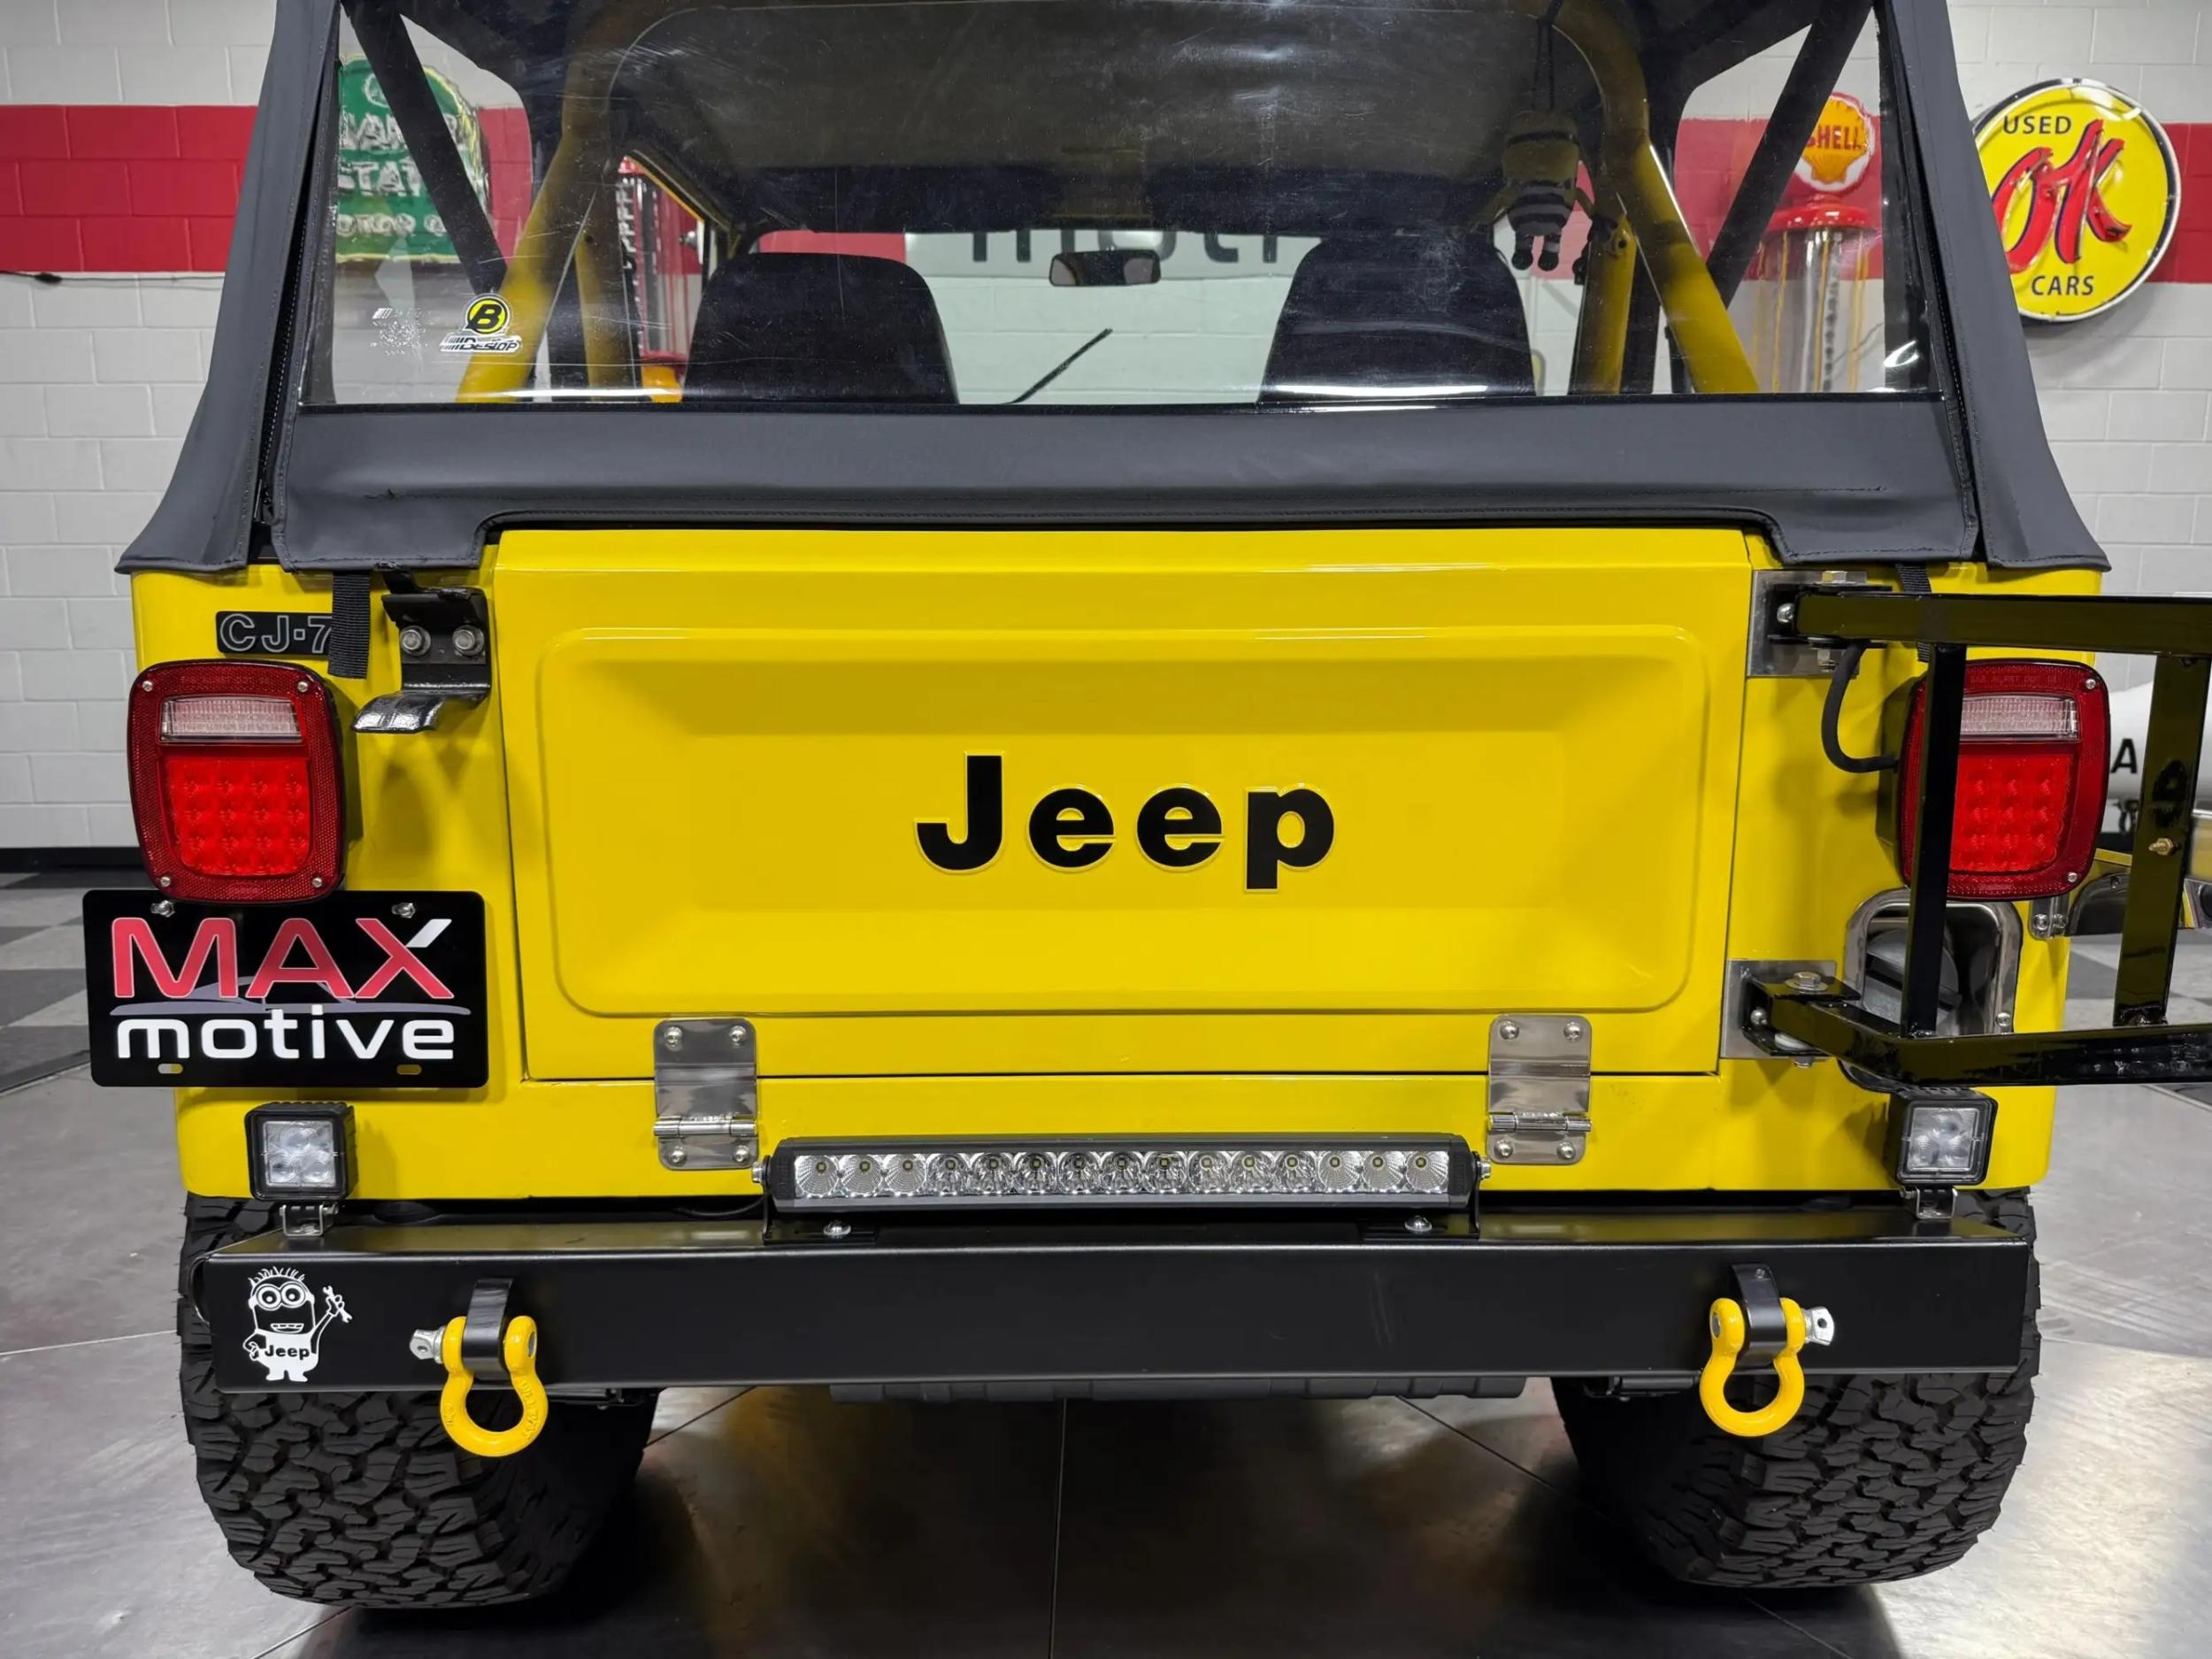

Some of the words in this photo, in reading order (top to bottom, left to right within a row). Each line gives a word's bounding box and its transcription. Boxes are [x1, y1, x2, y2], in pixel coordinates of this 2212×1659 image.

[2003, 116, 2072, 134] USED
[1992, 119, 2132, 274] OK
[2032, 276, 2094, 296] CARS
[915, 752, 1335, 891] Jeep
[111, 918, 455, 999] MAX
[117, 1004, 455, 1059] motive
[265, 1345, 310, 1360] Jeep
